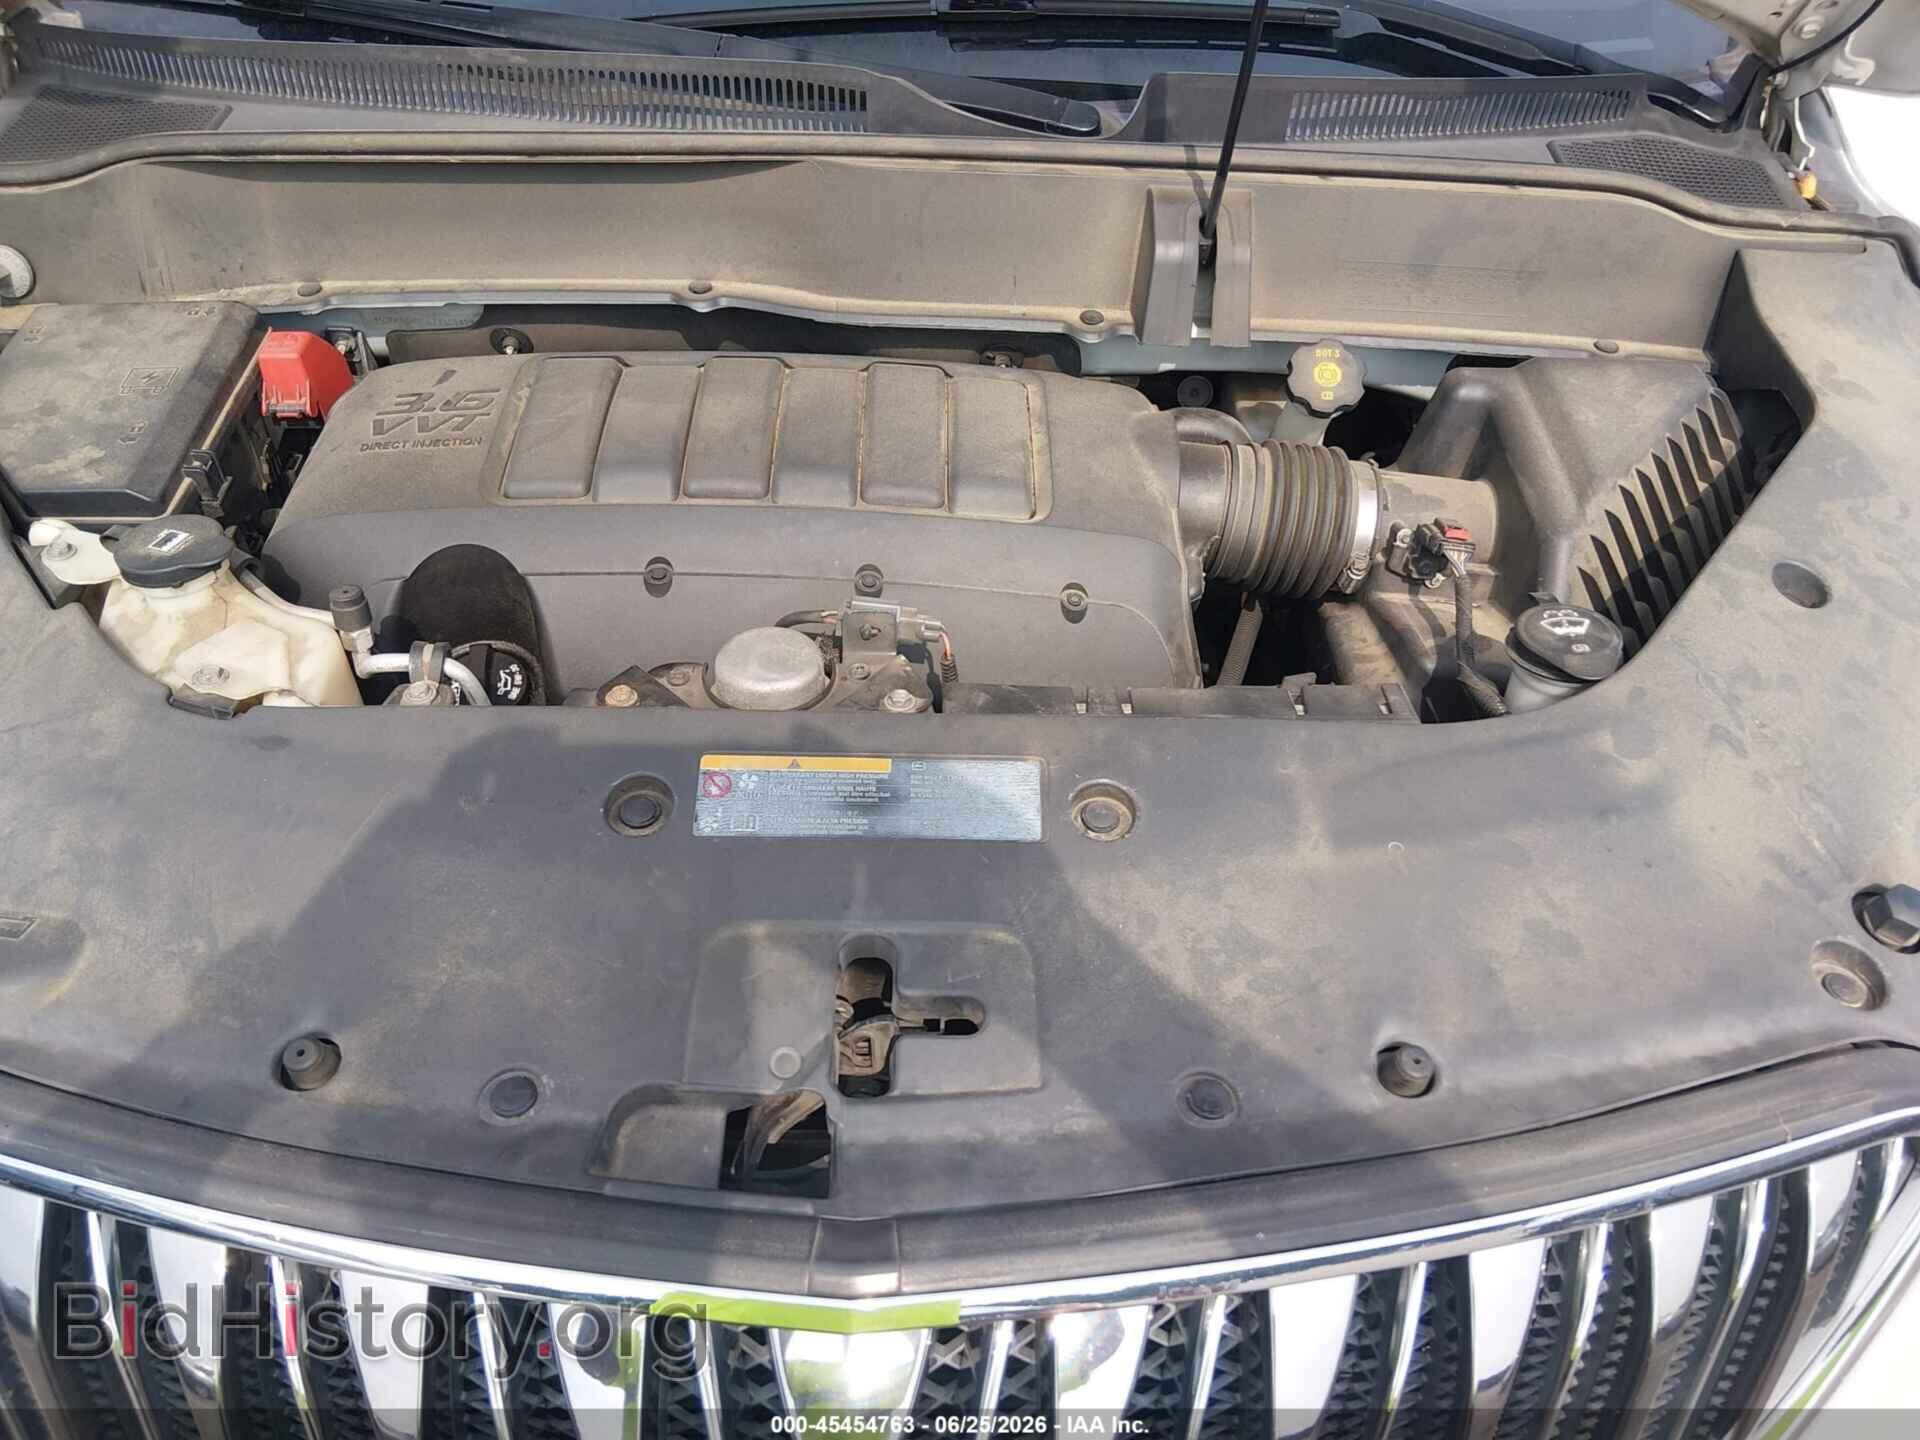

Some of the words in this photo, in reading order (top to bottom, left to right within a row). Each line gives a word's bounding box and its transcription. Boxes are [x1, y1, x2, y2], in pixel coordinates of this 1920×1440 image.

[376, 388, 501, 415] 3.6
[371, 412, 491, 437] VVT
[360, 439, 411, 452] DIRECT
[412, 437, 483, 449] INJECTION
